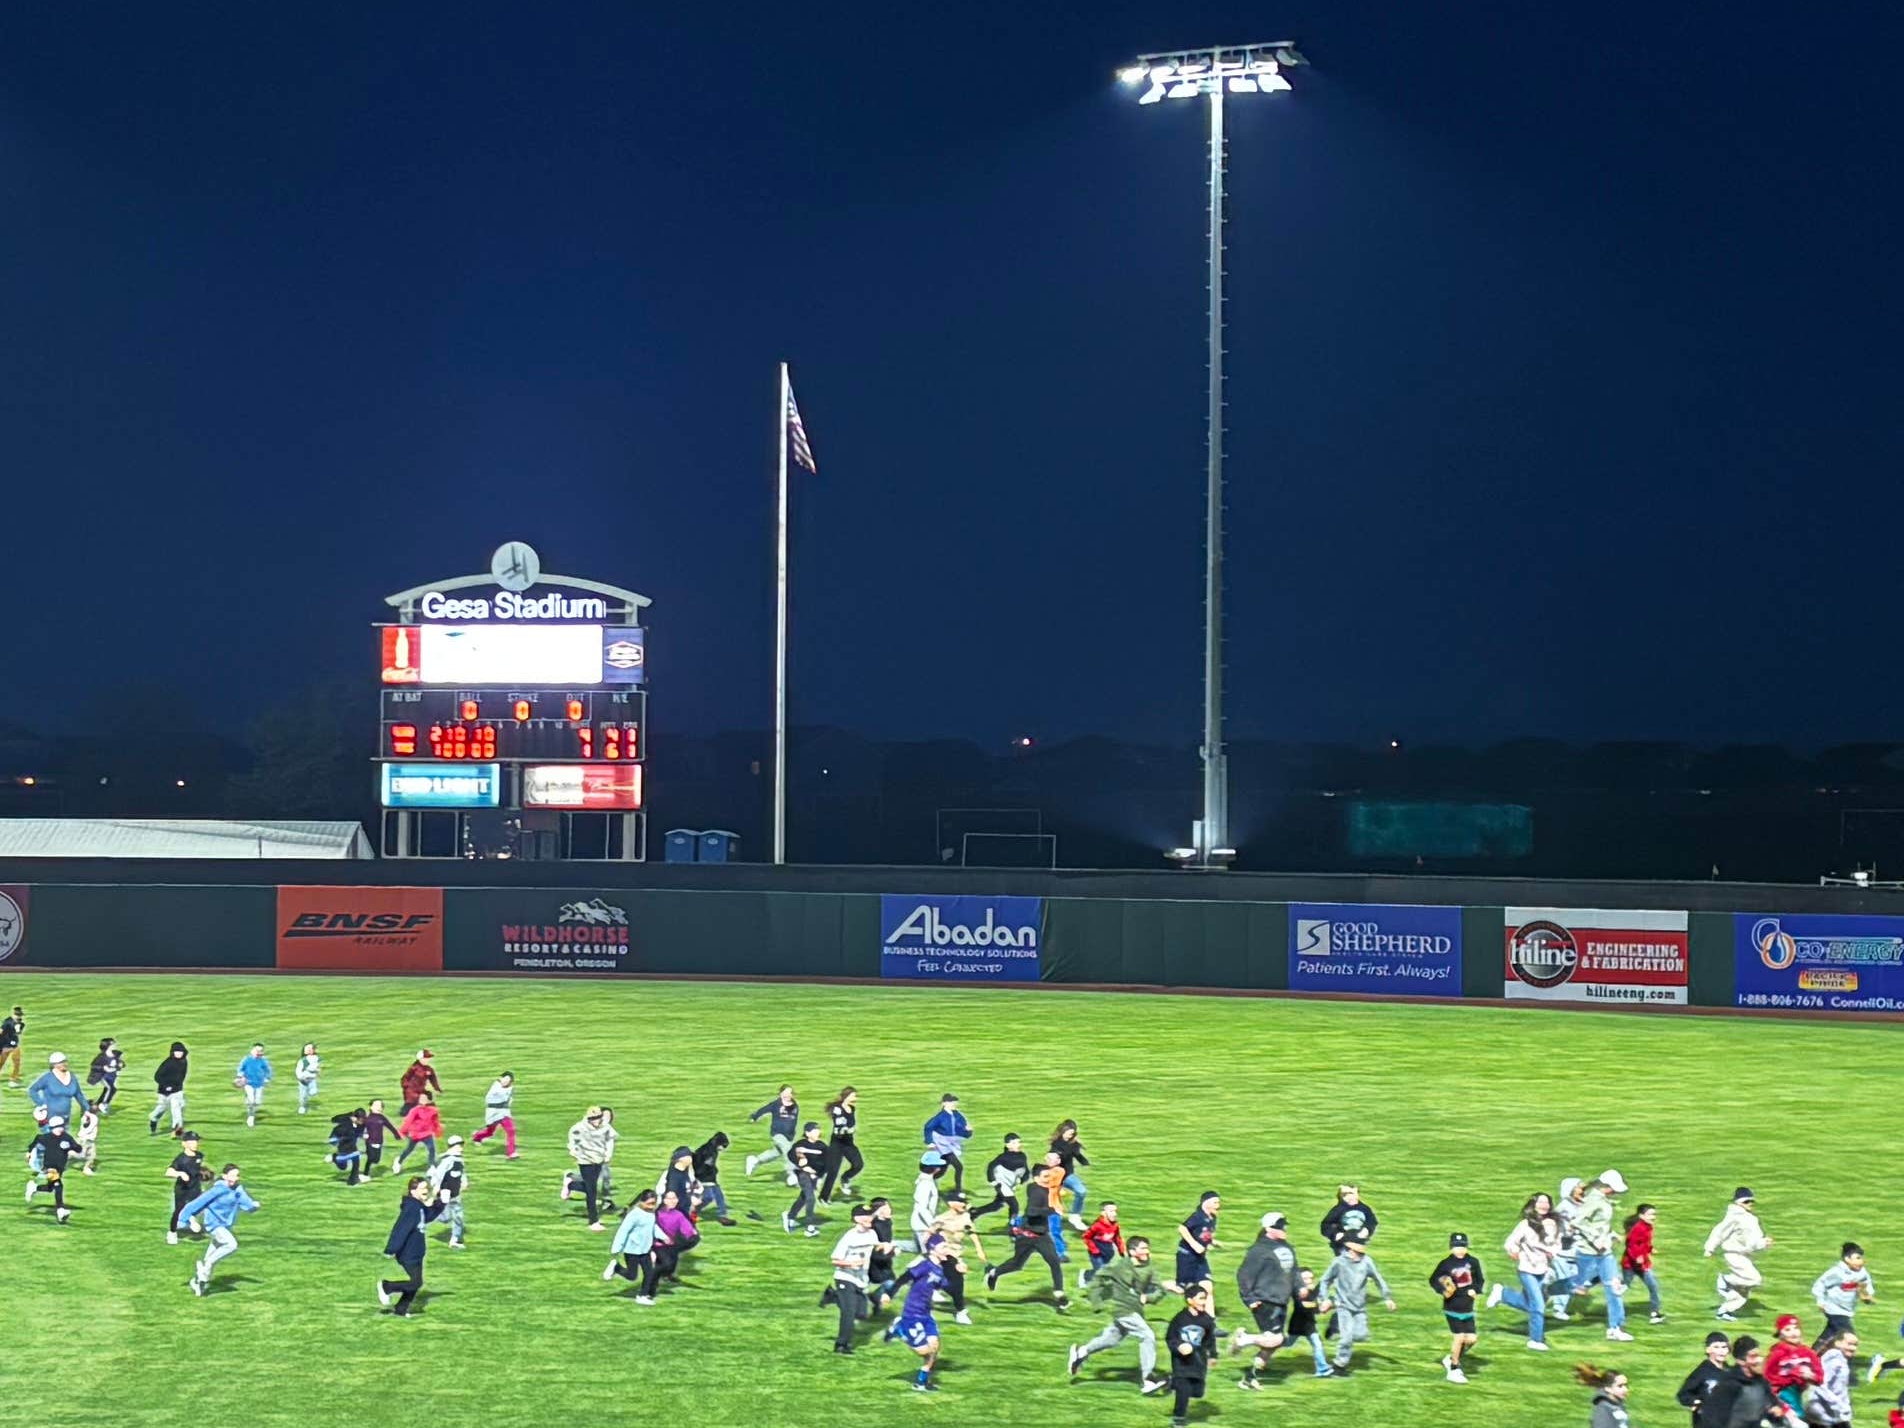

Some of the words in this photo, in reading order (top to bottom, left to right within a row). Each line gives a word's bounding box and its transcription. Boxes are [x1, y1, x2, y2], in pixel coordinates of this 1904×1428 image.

[421, 591, 490, 620] Gesa
[494, 591, 606, 620] Stadium
[290, 913, 434, 929] BNSF
[885, 905, 1036, 947] Abadan
[1333, 922, 1378, 935] GOOD
[353, 937, 419, 946] RAILWAY
[502, 924, 629, 945] WILDHORSE
[504, 944, 559, 954] RESORT
[573, 944, 628, 955] CASINO
[1332, 934, 1451, 955] SHEPHERD
[1510, 938, 1577, 967] hiline
[1586, 942, 1679, 958] ENGINEERING
[883, 947, 924, 957] BUSINESS
[925, 947, 985, 958] TECHNOLOGY
[987, 949, 1038, 959] SOLUTIONS
[575, 958, 617, 968] OREGON
[1297, 961, 1354, 976] Patients
[1357, 961, 1392, 977] First.
[1394, 965, 1451, 980] Always!
[1581, 956, 1591, 969] &
[1593, 956, 1684, 972] FABRICATION
[1585, 985, 1676, 1002] hilineeng.com
